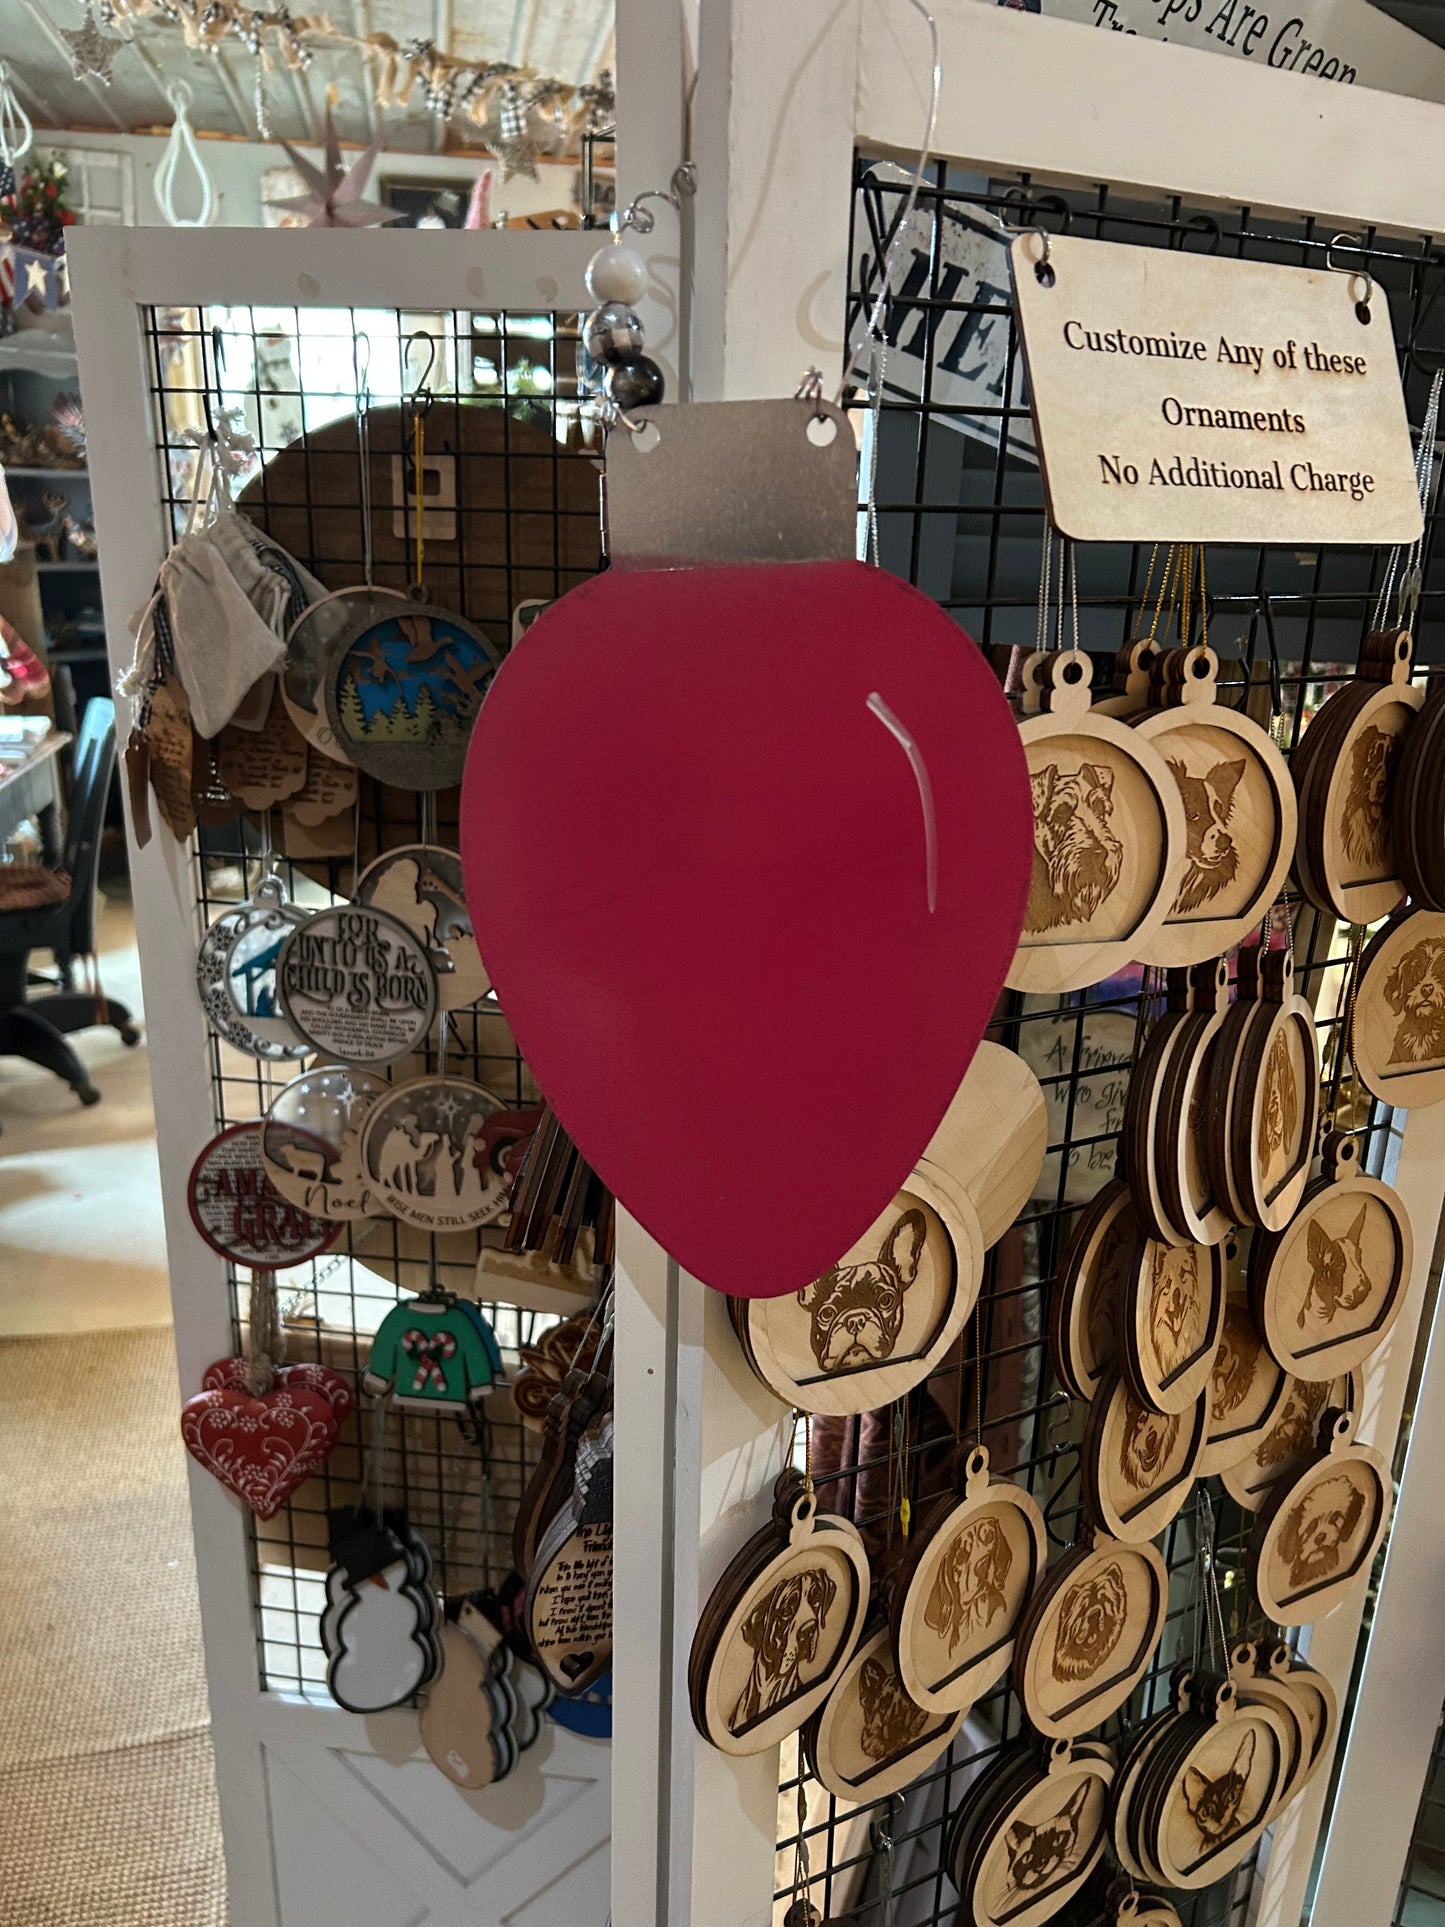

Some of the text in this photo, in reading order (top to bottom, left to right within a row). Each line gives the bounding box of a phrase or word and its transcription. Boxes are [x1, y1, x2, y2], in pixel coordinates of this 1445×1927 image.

[1204, 0, 1269, 56] Are
[1063, 320, 1367, 376] Customize Any of these
[1161, 397, 1305, 433] Ornaments
[1097, 454, 1375, 501] No Additional Charge
[296, 933, 357, 968] UNTO
[337, 912, 391, 951] FOR
[286, 963, 428, 1011] CHILD IS BORN
[305, 1184, 370, 1215] Noel
[387, 1193, 409, 1214] WISE
[409, 1208, 434, 1224] MEN
[437, 1214, 466, 1226] STILL
[468, 1205, 495, 1221] SEEK
